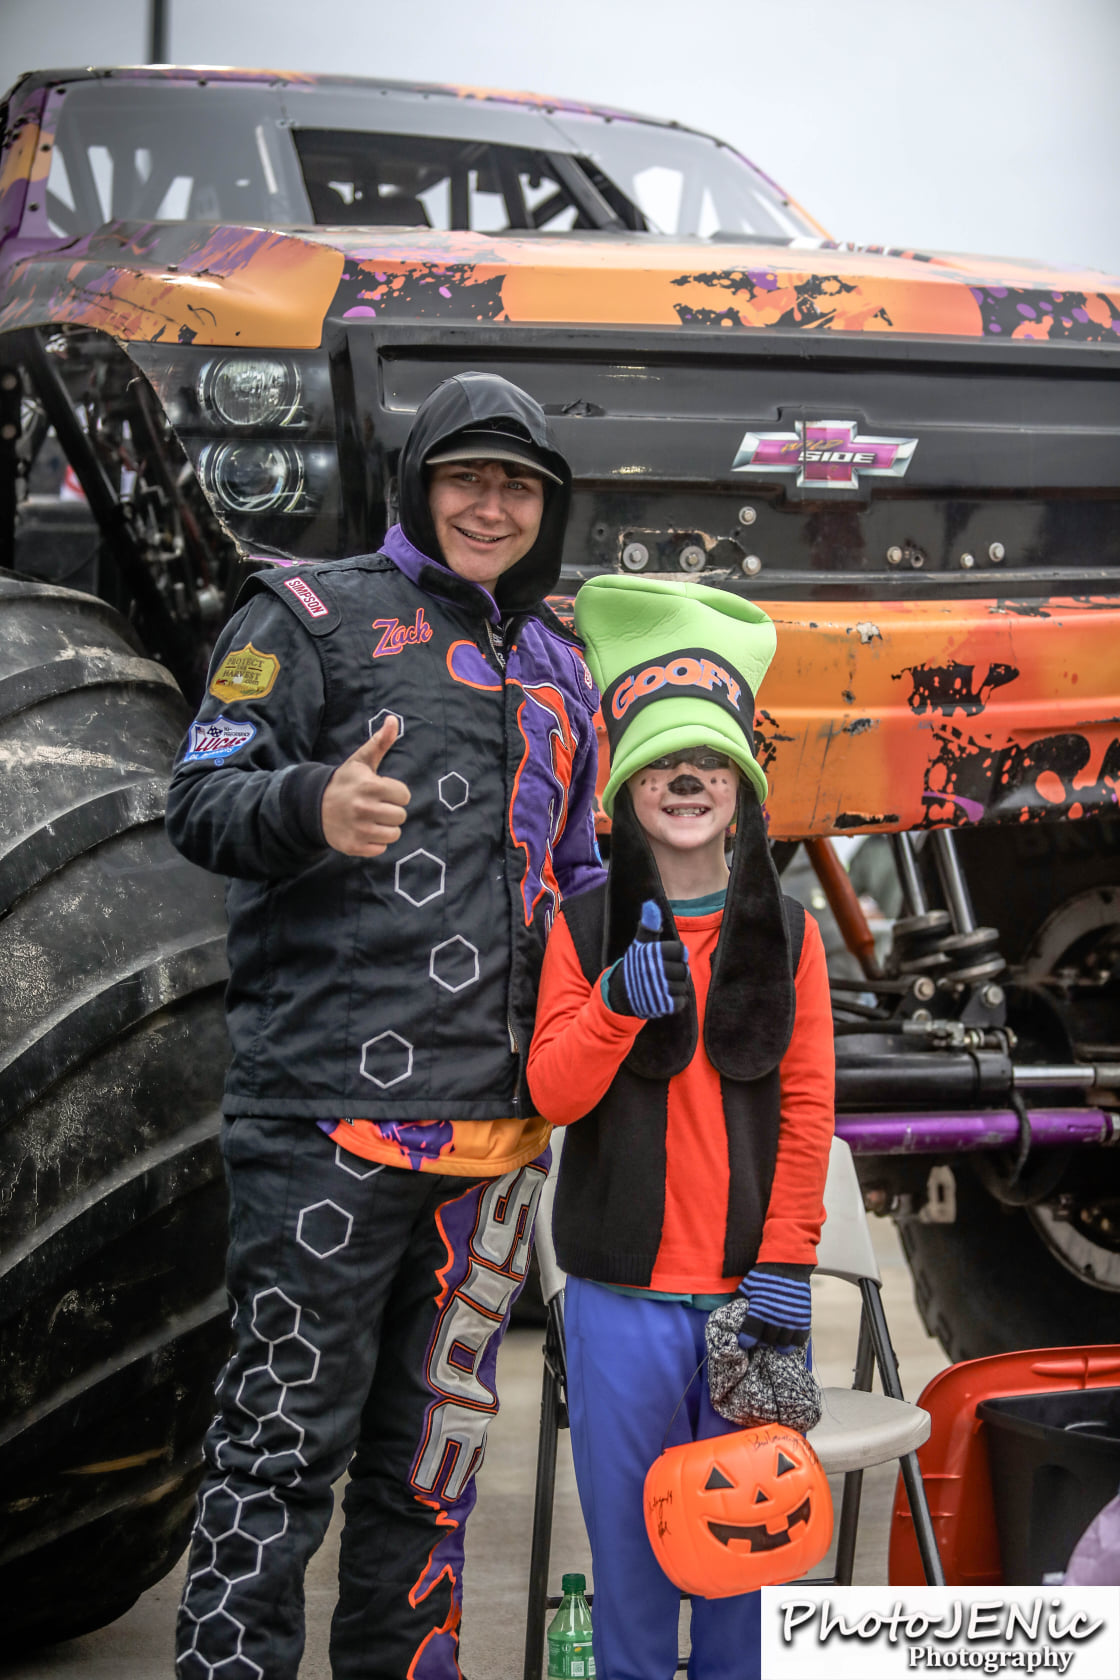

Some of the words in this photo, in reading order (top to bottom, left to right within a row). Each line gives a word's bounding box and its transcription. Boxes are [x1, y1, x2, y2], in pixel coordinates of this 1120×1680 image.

[798, 450, 876, 464] SIDE
[288, 578, 325, 616] SIMPSON
[371, 607, 433, 658] Zack
[611, 657, 742, 720] GOOFY
